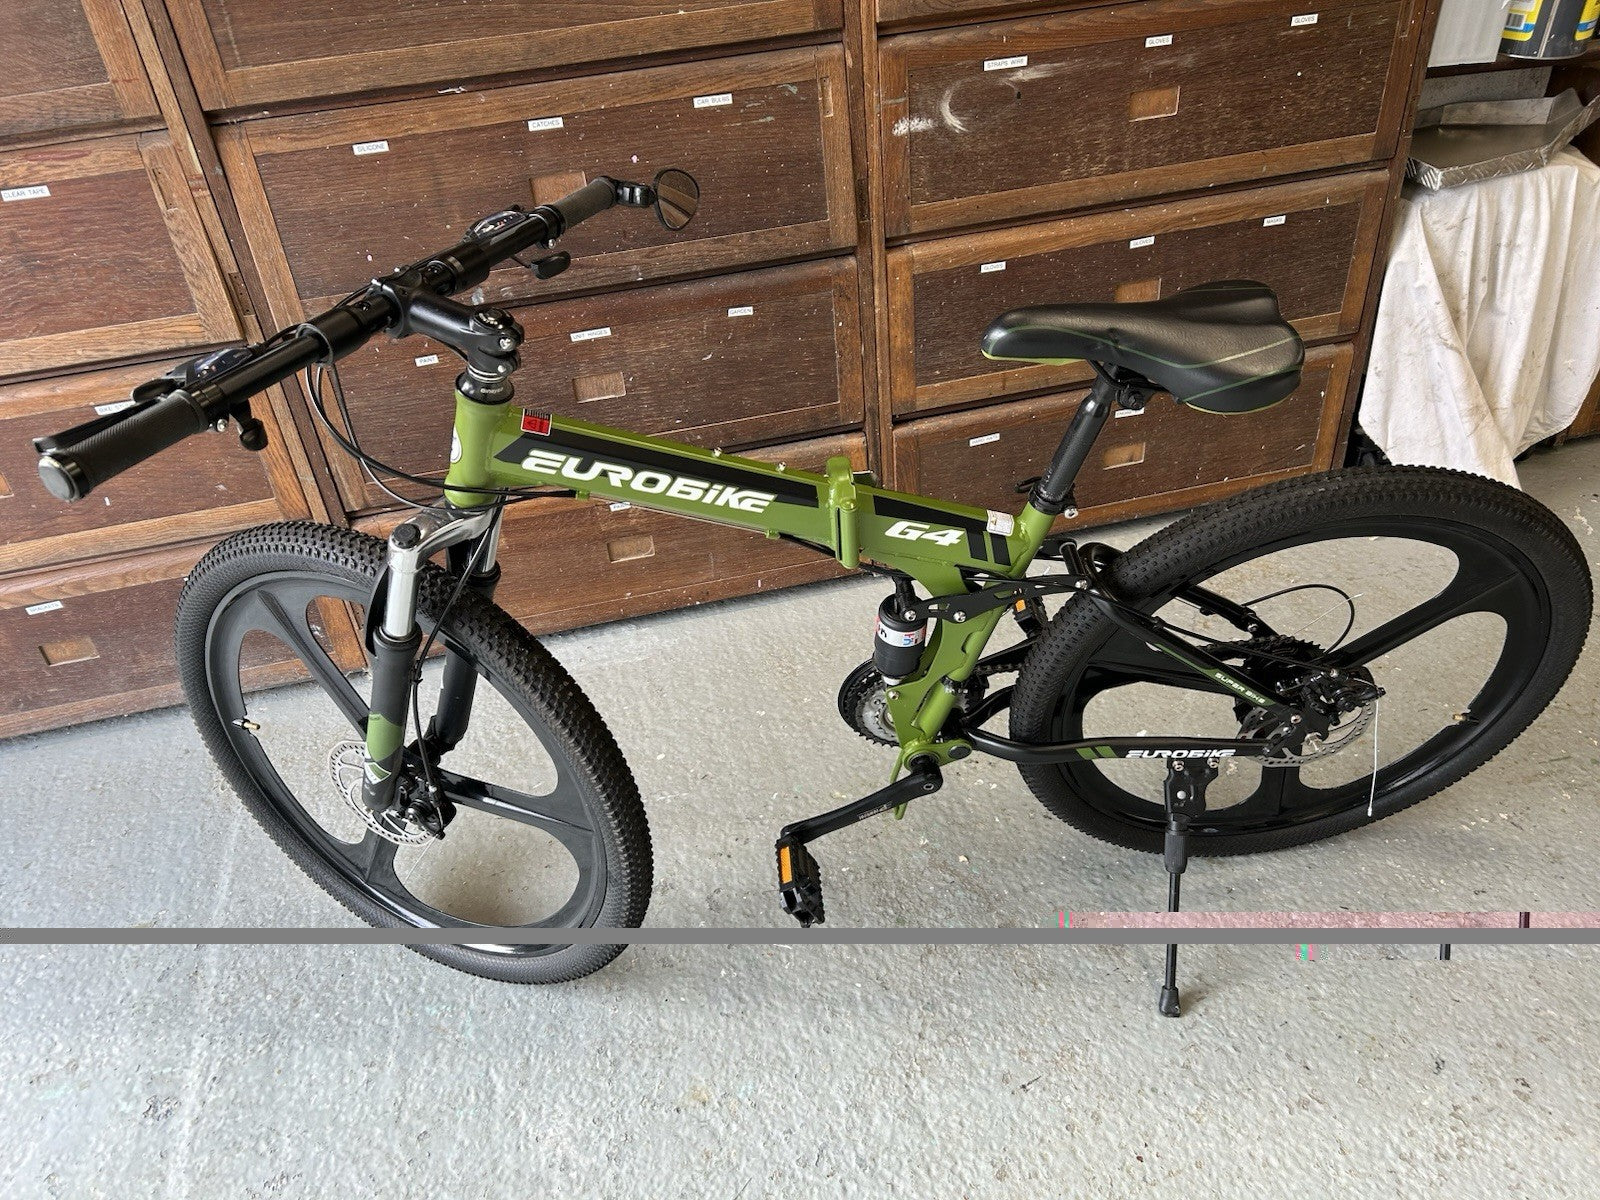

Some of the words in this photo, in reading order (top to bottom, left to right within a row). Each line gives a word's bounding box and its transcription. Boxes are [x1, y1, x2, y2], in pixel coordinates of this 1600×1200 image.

[1148, 36, 1170, 45] GLOVES
[987, 60, 1008, 69] STRAPS
[531, 119, 559, 129] CATCHES
[356, 142, 385, 153] SILICONE
[3, 189, 26, 200] CLEAR
[28, 188, 46, 196] TAPE
[885, 520, 965, 547] G4
[1214, 672, 1245, 692] SUPER
